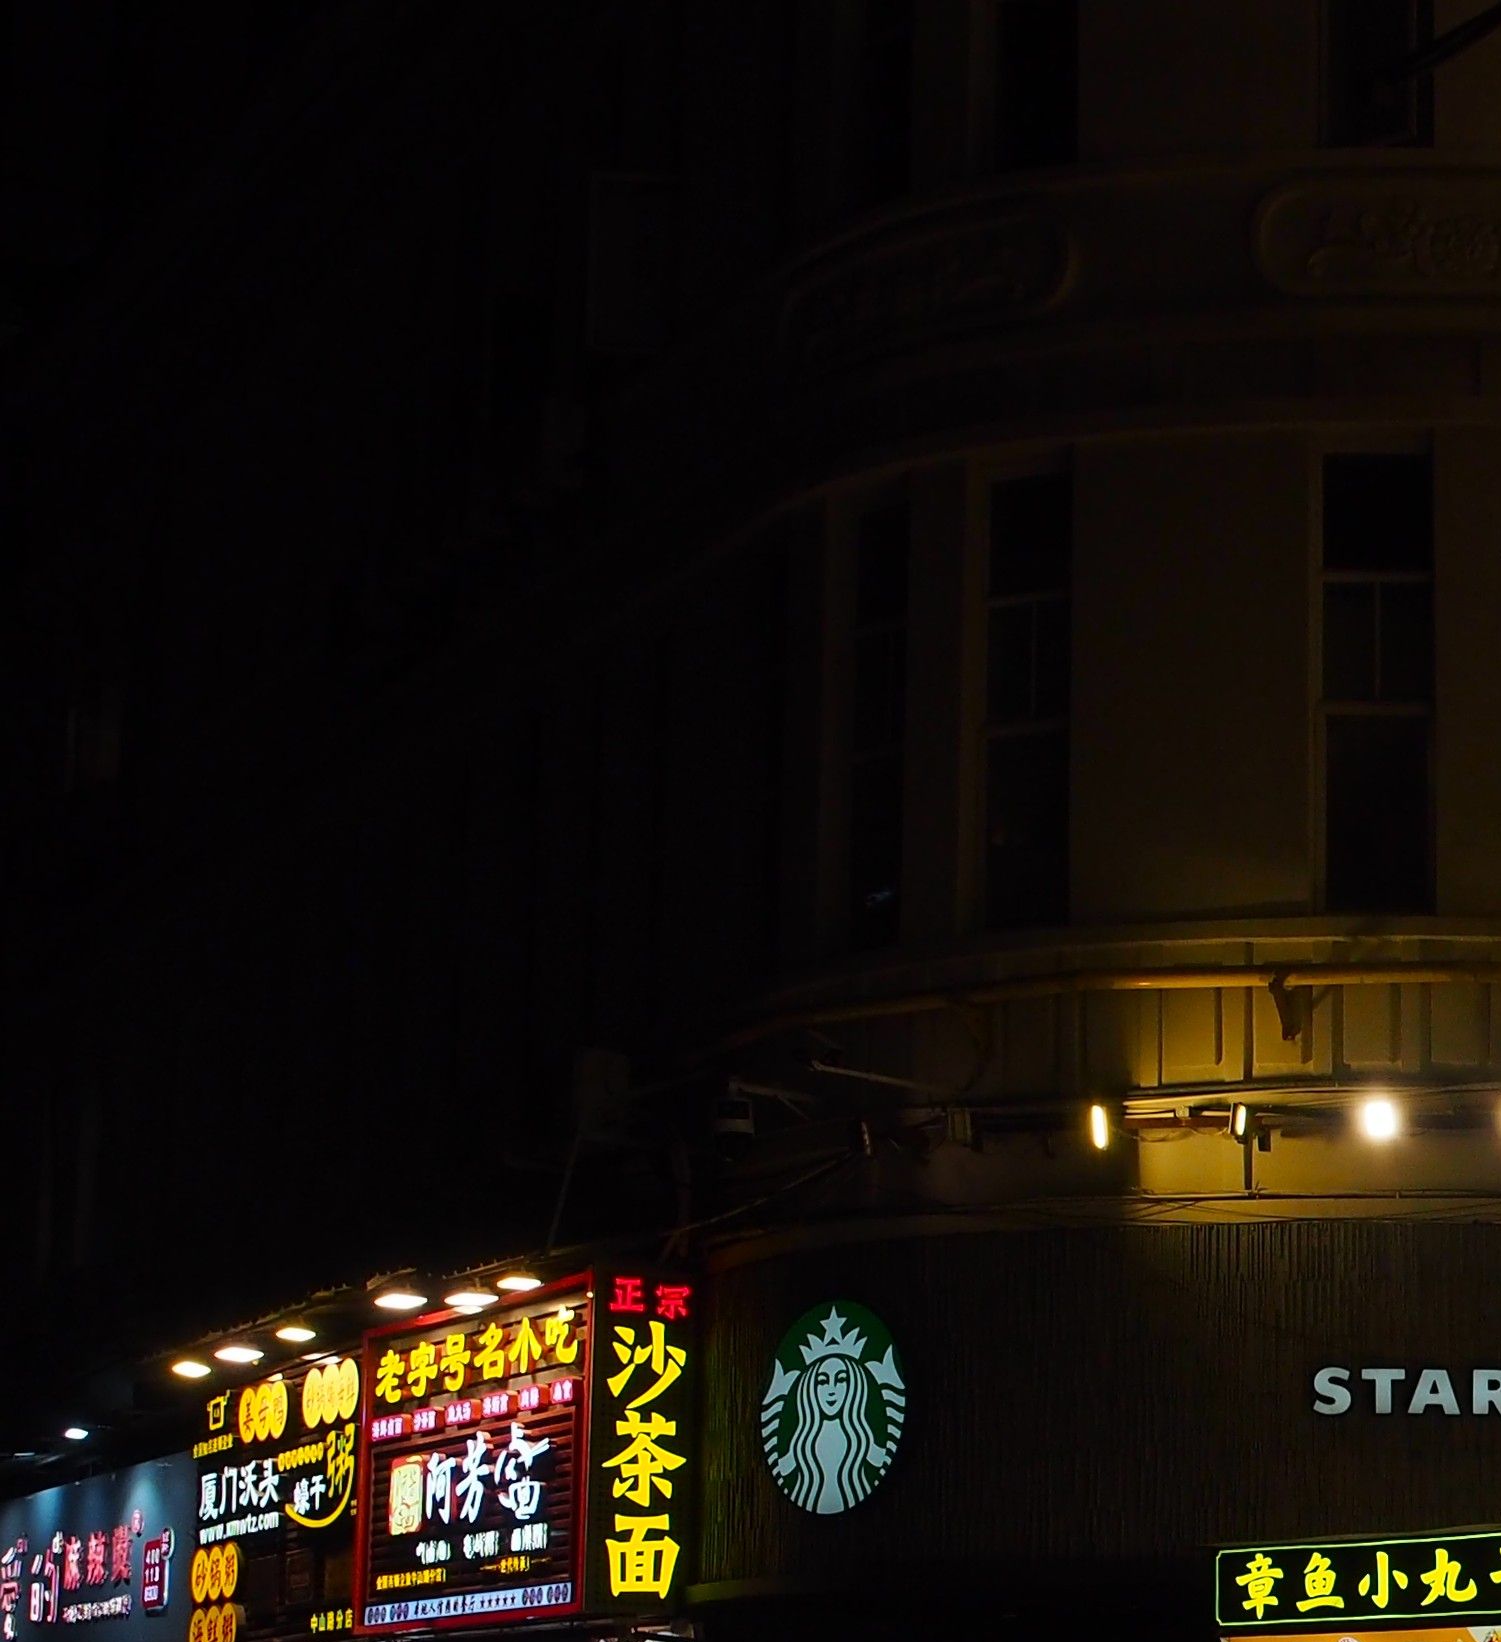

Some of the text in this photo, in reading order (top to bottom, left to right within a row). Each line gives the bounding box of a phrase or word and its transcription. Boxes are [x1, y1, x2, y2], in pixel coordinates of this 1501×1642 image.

[610, 1278, 689, 1319] 正宗
[376, 1305, 578, 1403] 老字号名小吃
[199, 1459, 279, 1520] 厦门沃头
[601, 1321, 687, 1600] 沙茶面
[310, 1608, 353, 1633] 中山路分店
